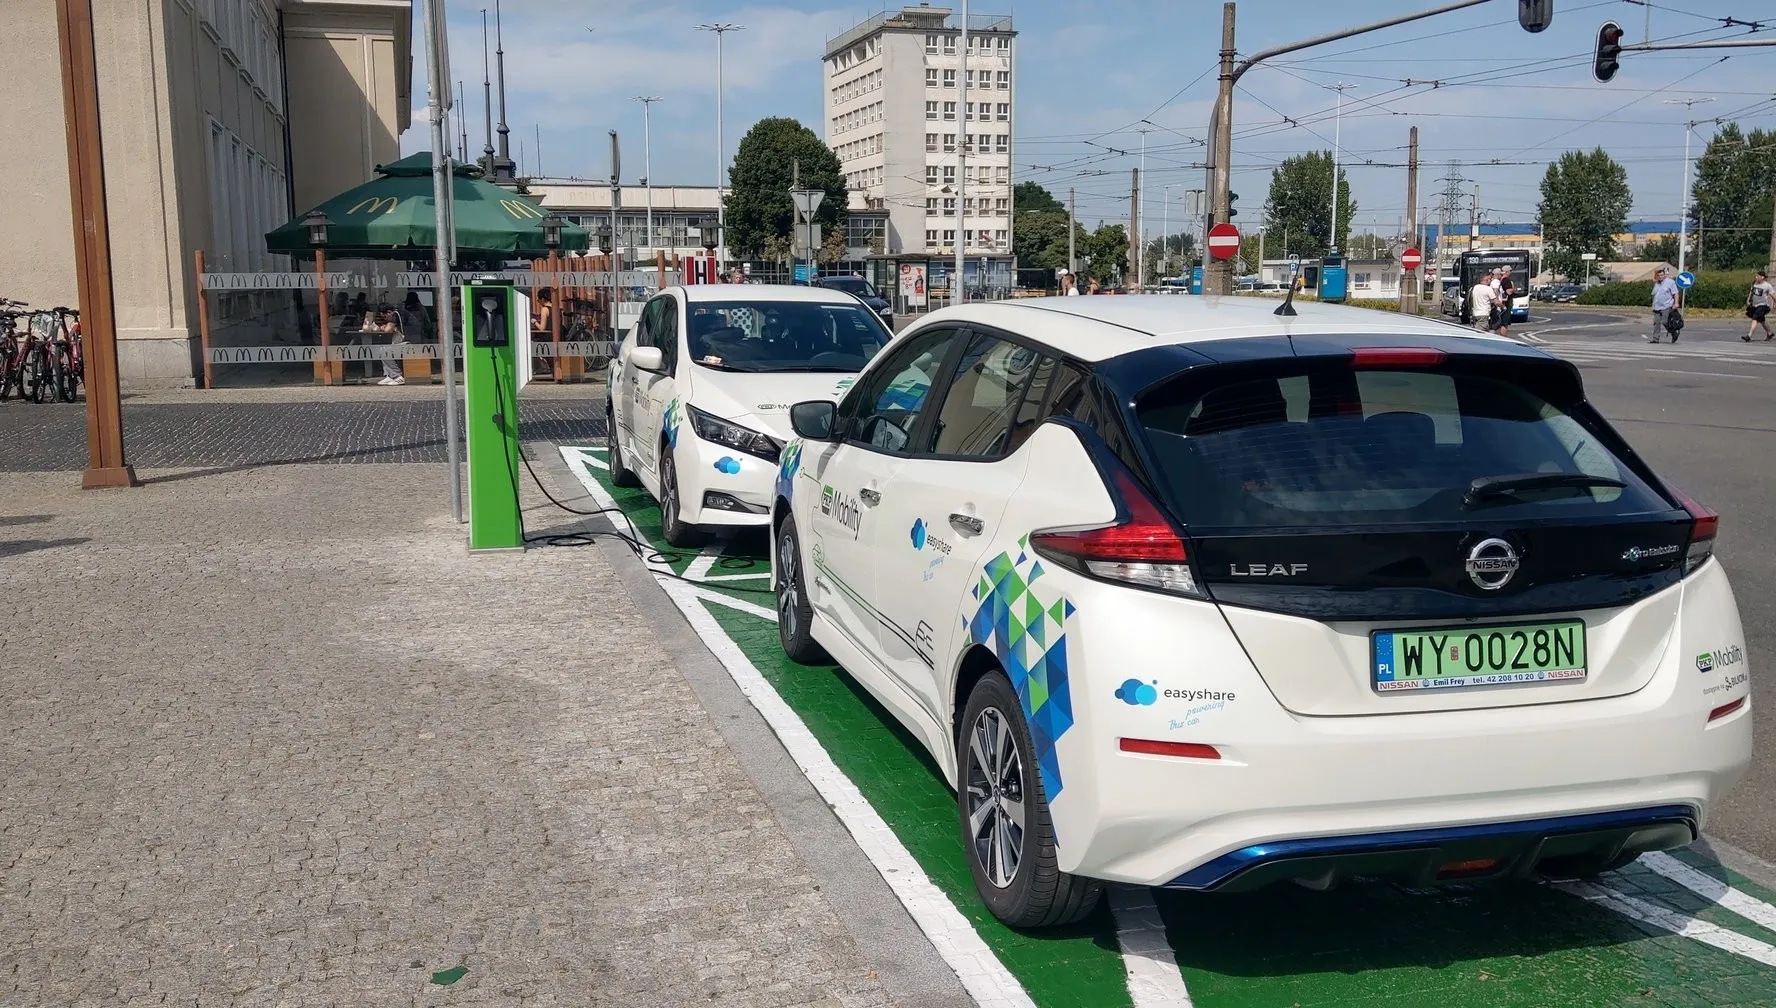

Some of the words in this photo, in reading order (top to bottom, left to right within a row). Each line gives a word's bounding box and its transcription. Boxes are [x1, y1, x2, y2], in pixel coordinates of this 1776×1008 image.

[832, 490, 863, 541] Mobility
[926, 534, 952, 556] easyshare
[1230, 563, 1309, 576] LEAF
[1472, 559, 1518, 570] NISSAN
[1402, 635, 1449, 677] WY
[1464, 628, 1575, 672] 0028N
[1712, 645, 1744, 669] Mobility
[1378, 663, 1392, 675] PL
[1548, 669, 1584, 679] NISSAN
[1433, 678, 1449, 686] Emil
[1450, 677, 1465, 687] Frey
[1472, 676, 1485, 684] tel.
[1487, 675, 1497, 683] 42
[1498, 674, 1512, 683] 208
[1514, 673, 1524, 681] 10
[1525, 672, 1535, 681] 20
[1379, 680, 1419, 691] NISSAN
[1164, 688, 1236, 701] easyshare
[1185, 701, 1225, 720] powering
